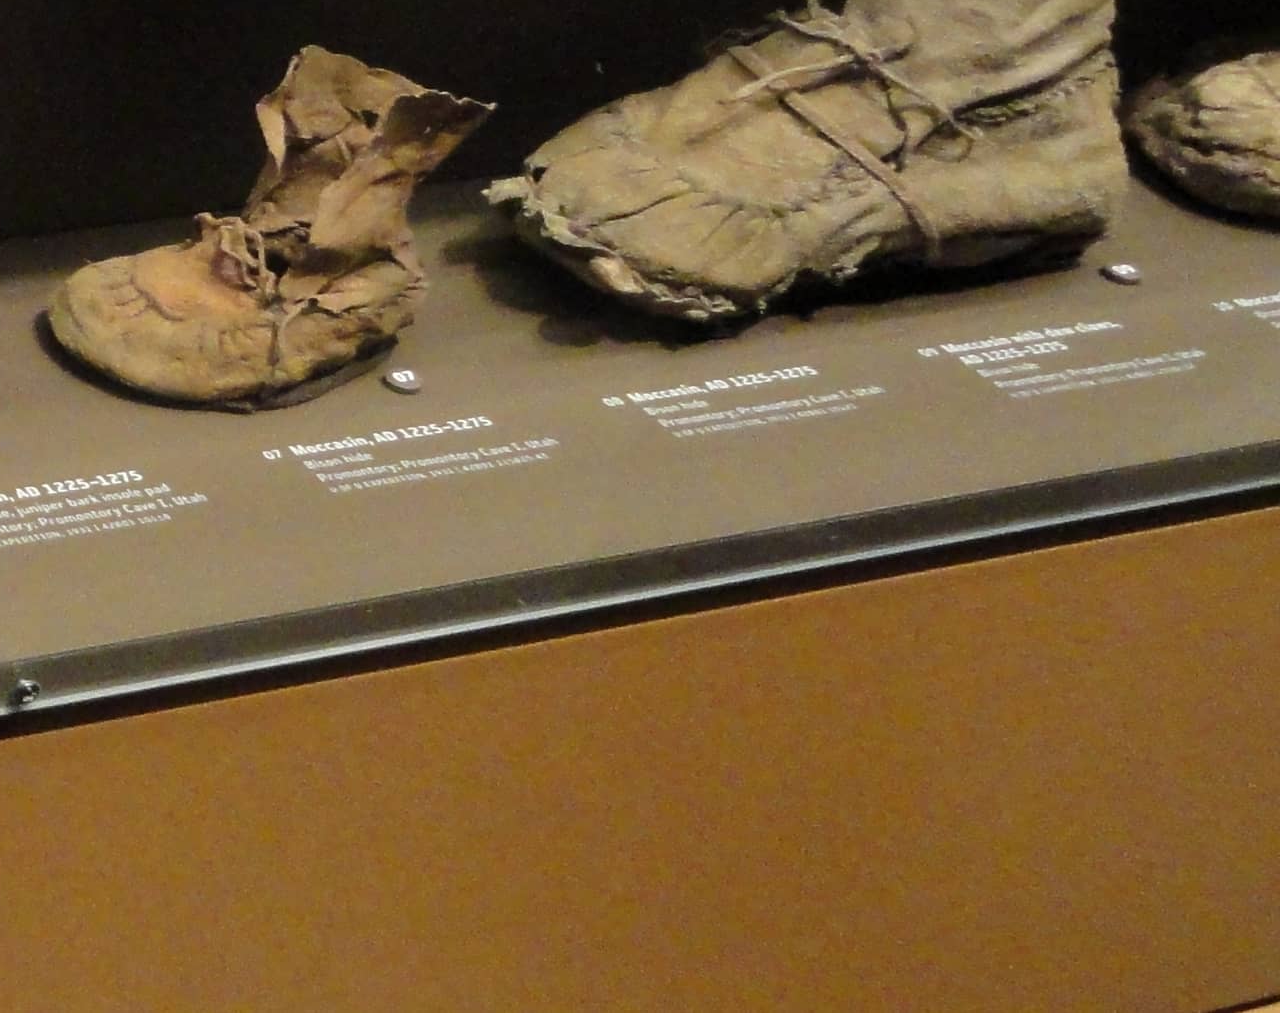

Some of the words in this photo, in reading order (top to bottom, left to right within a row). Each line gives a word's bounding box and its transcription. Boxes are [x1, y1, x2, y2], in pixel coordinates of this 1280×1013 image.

[391, 369, 416, 383] 07
[261, 448, 281, 460] 07
[288, 436, 374, 455] Moccasin,
[372, 430, 398, 442] AD
[15, 485, 41, 499] AD
